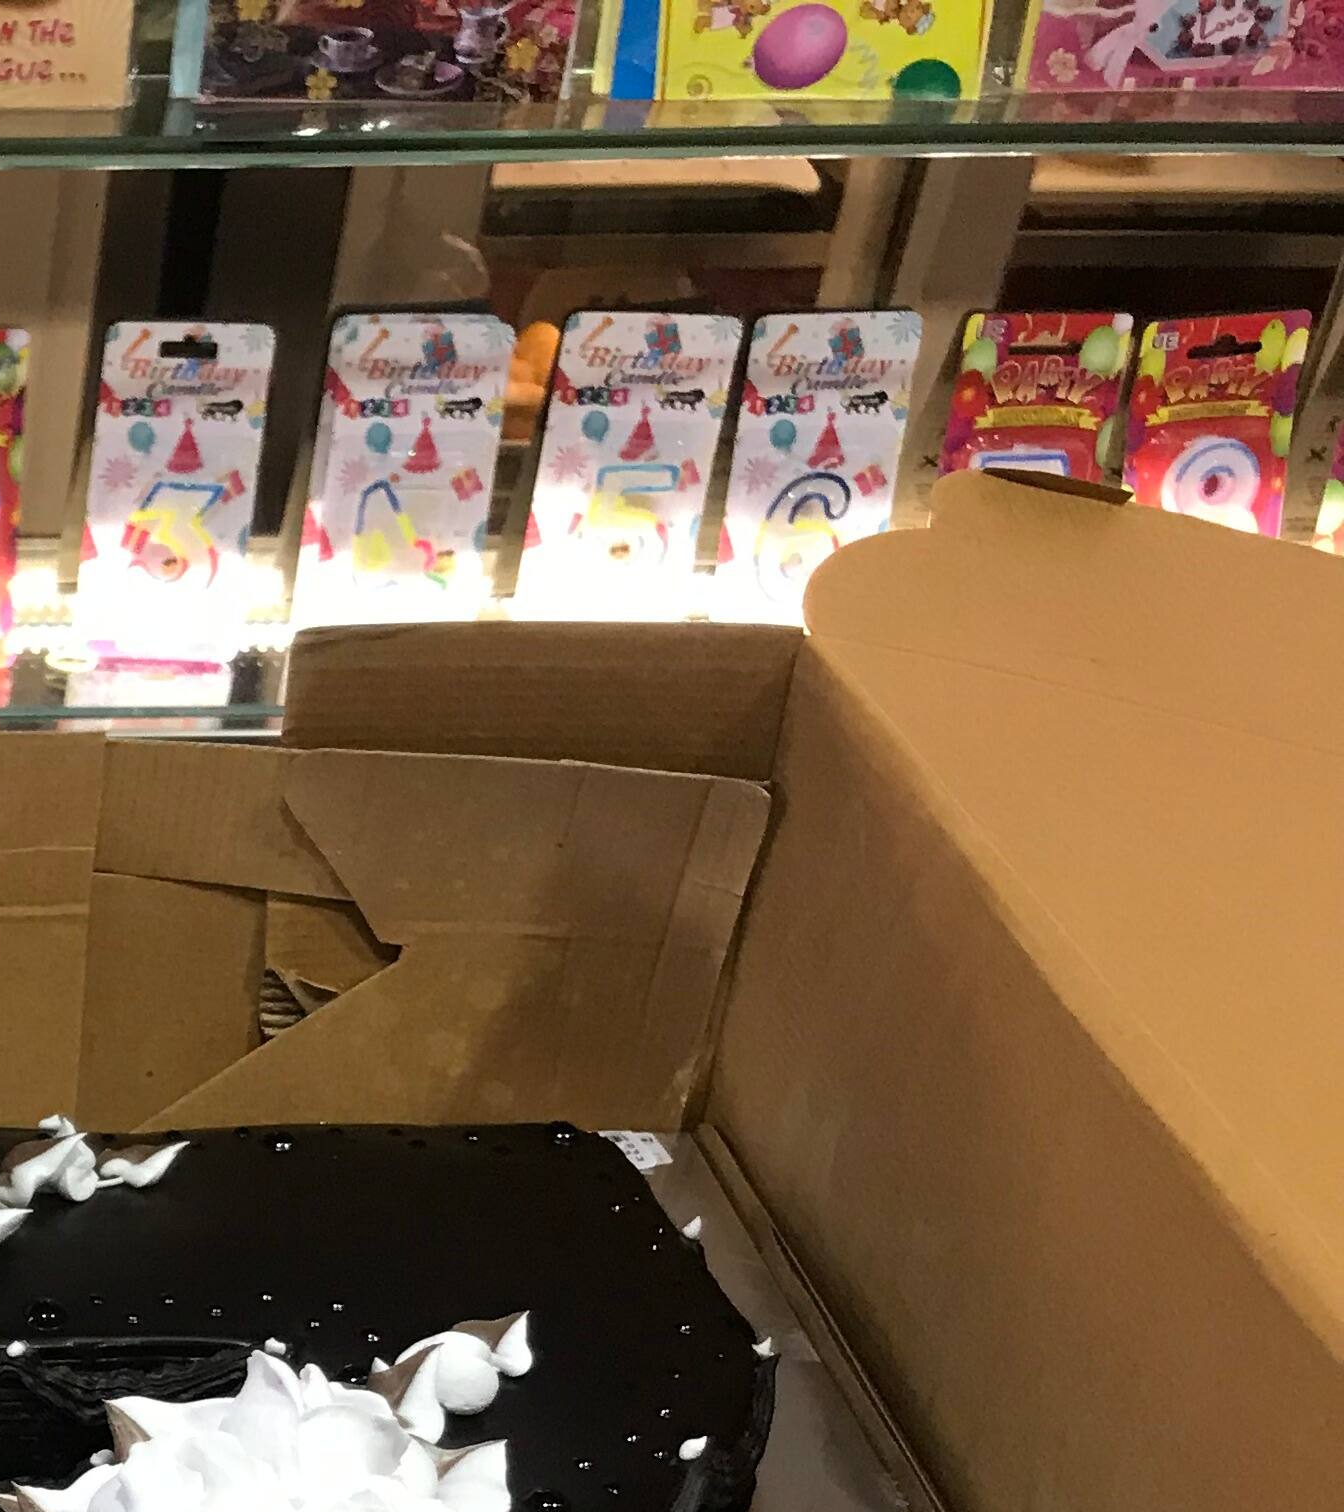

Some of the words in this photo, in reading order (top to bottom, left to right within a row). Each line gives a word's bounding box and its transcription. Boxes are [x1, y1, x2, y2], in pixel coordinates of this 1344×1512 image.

[127, 357, 247, 388] Birthday
[367, 358, 488, 383] Birthday
[586, 347, 711, 373] Birthday
[773, 354, 893, 377] Birthday
[992, 354, 1103, 404] PARTY
